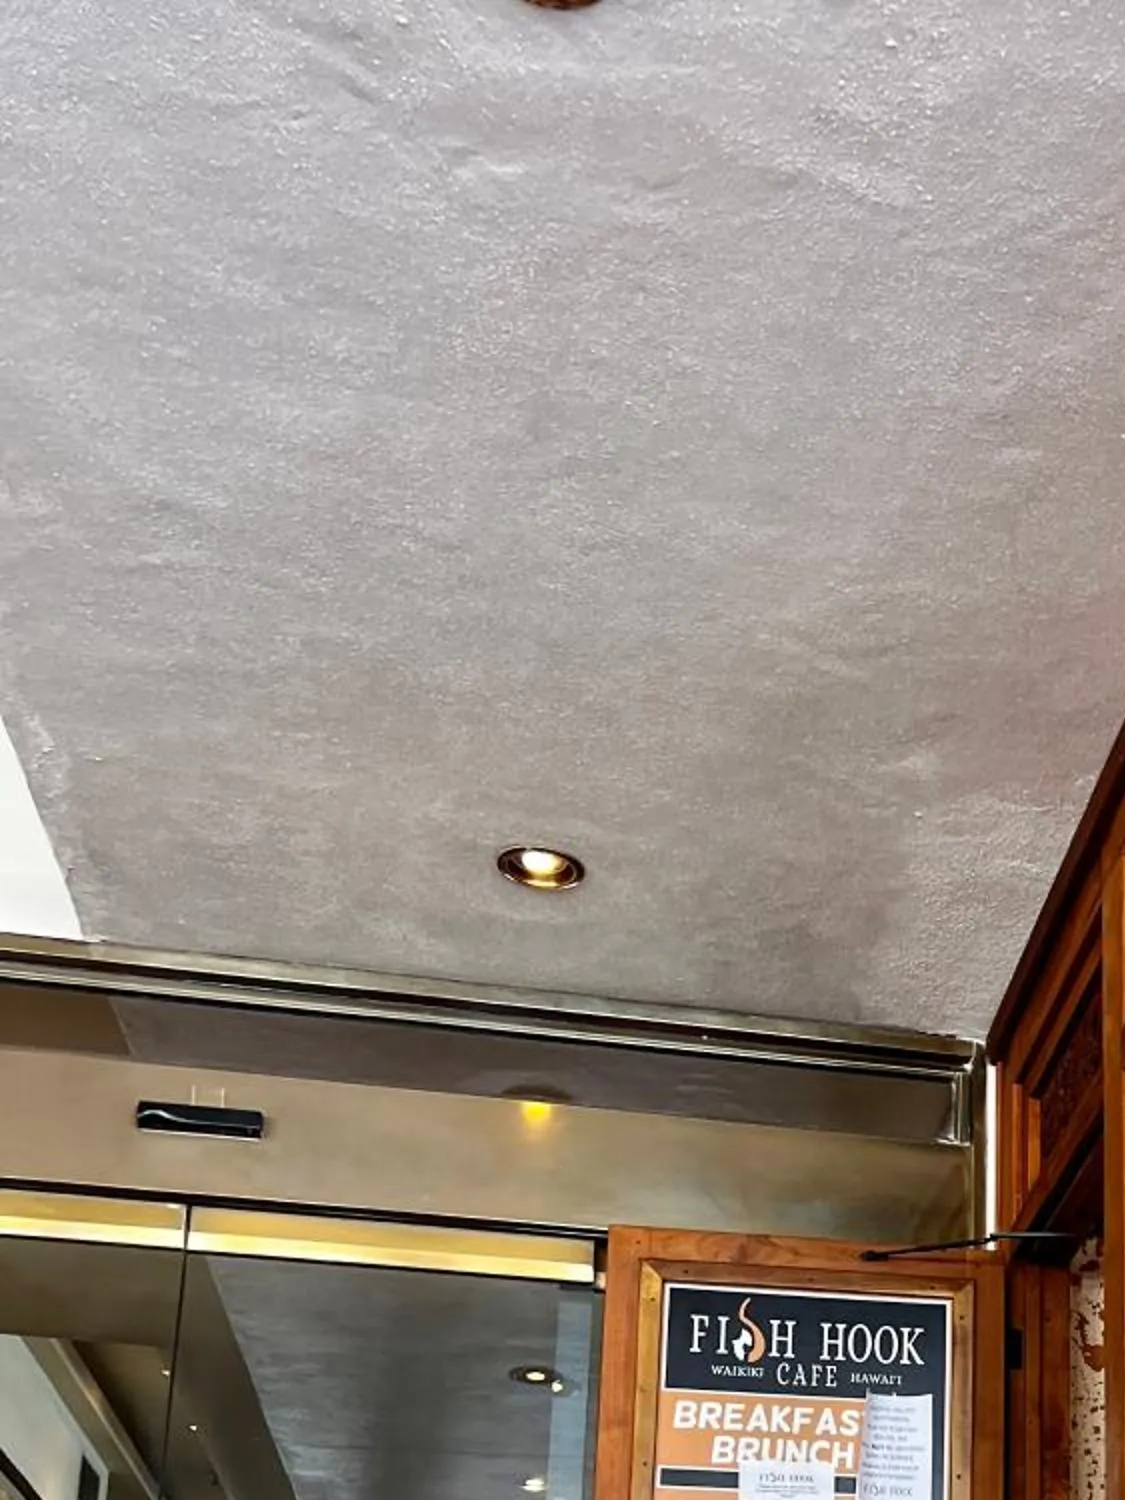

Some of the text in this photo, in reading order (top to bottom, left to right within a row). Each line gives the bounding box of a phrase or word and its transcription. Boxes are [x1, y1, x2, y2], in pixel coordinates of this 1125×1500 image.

[689, 1297, 926, 1366] FISH HOOK
[711, 1364, 765, 1378] WAIKIKI
[776, 1361, 838, 1388] CAFE
[673, 1400, 865, 1437] BREAKFAS
[711, 1435, 854, 1470] BRUNCH
